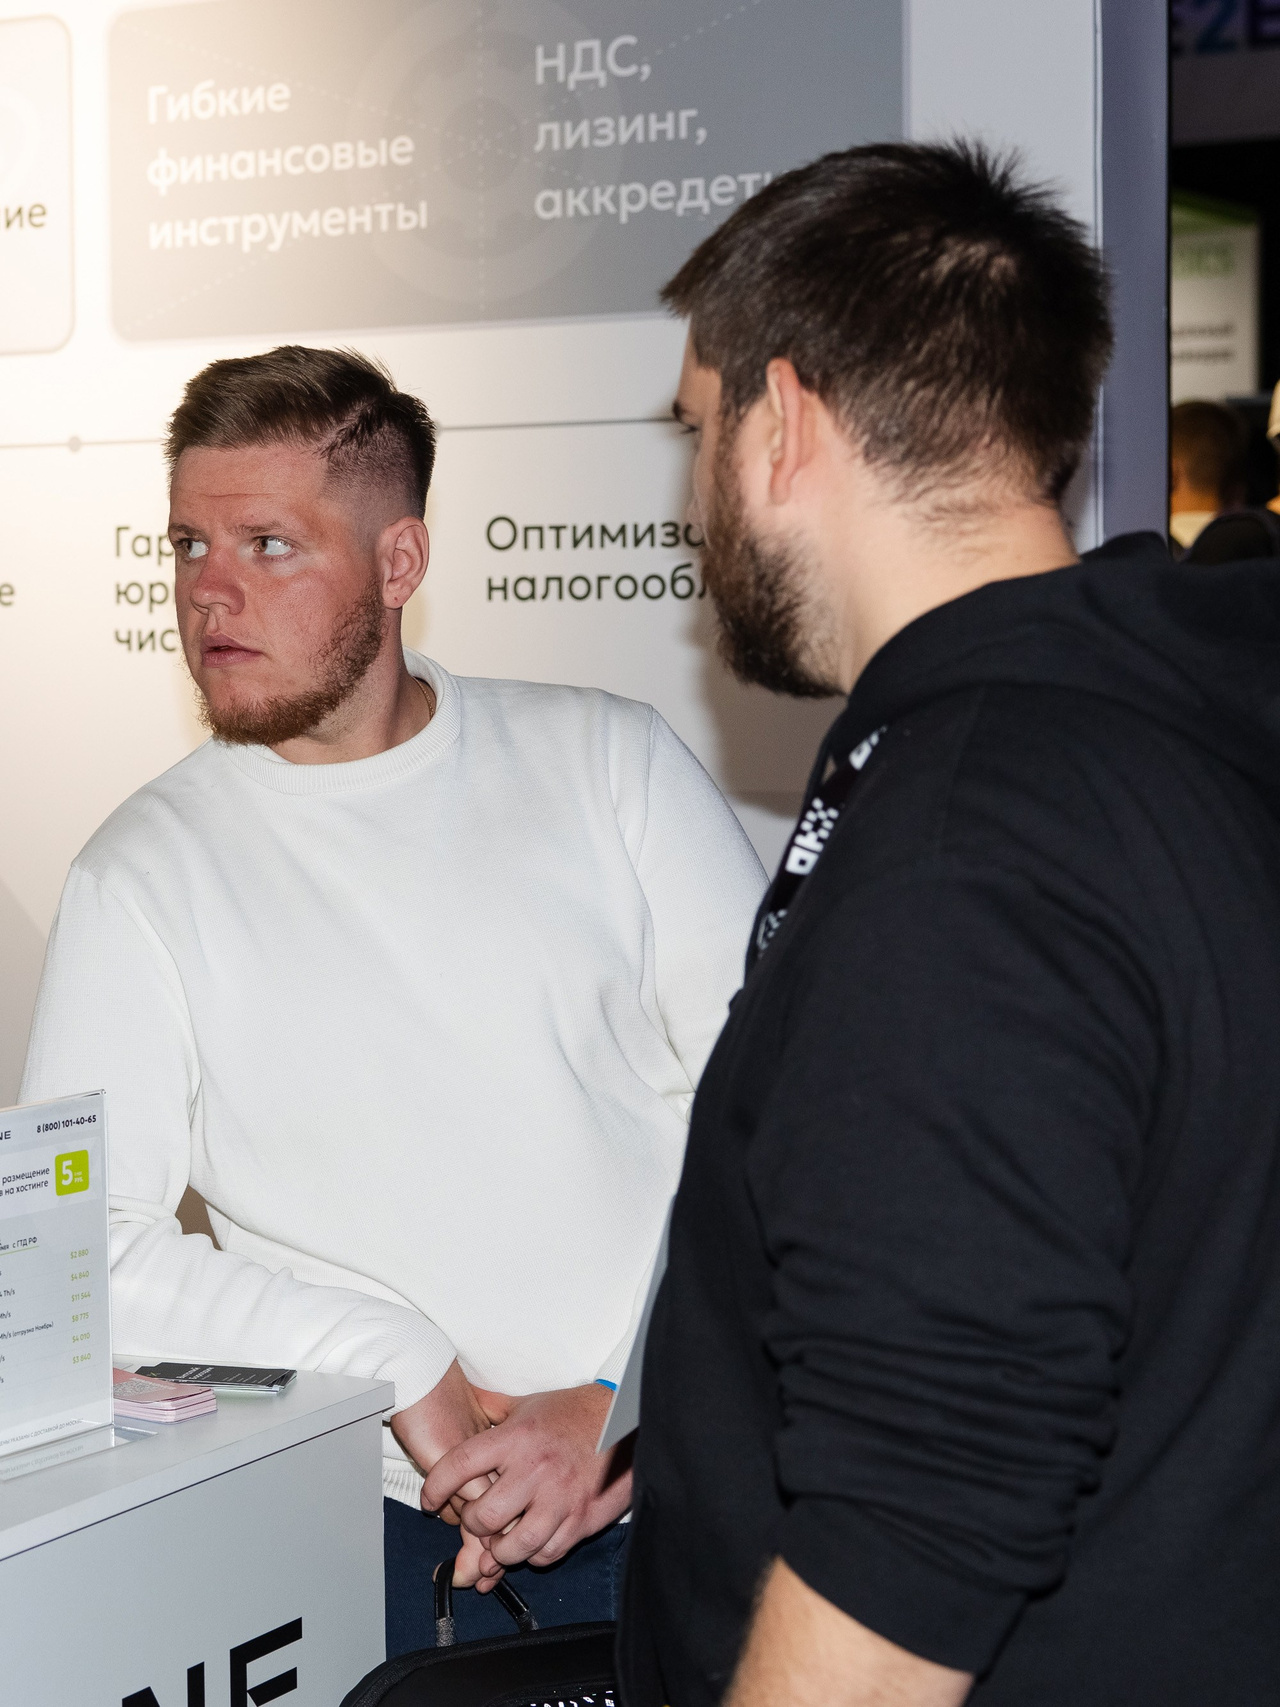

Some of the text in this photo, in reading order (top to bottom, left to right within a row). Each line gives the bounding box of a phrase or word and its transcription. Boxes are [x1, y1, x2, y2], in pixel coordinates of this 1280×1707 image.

[535, 35, 651, 90] НДС,
[146, 81, 291, 124] Гибкие
[534, 108, 707, 153] лизинг,
[147, 135, 414, 195] финансовые
[147, 201, 428, 251] инструменты
[115, 582, 176, 614] юр
[37, 1125, 41, 1133] 8
[42, 1120, 61, 1132] (800)
[62, 1115, 97, 1128] 101-40-65
[2, 1167, 50, 1185] размещение
[5, 1187, 14, 1195] на
[15, 1180, 49, 1193] хостинге
[61, 1160, 73, 1186] 5
[28, 1237, 37, 1245] РФ
[3, 1288, 15, 1297] Th/s
